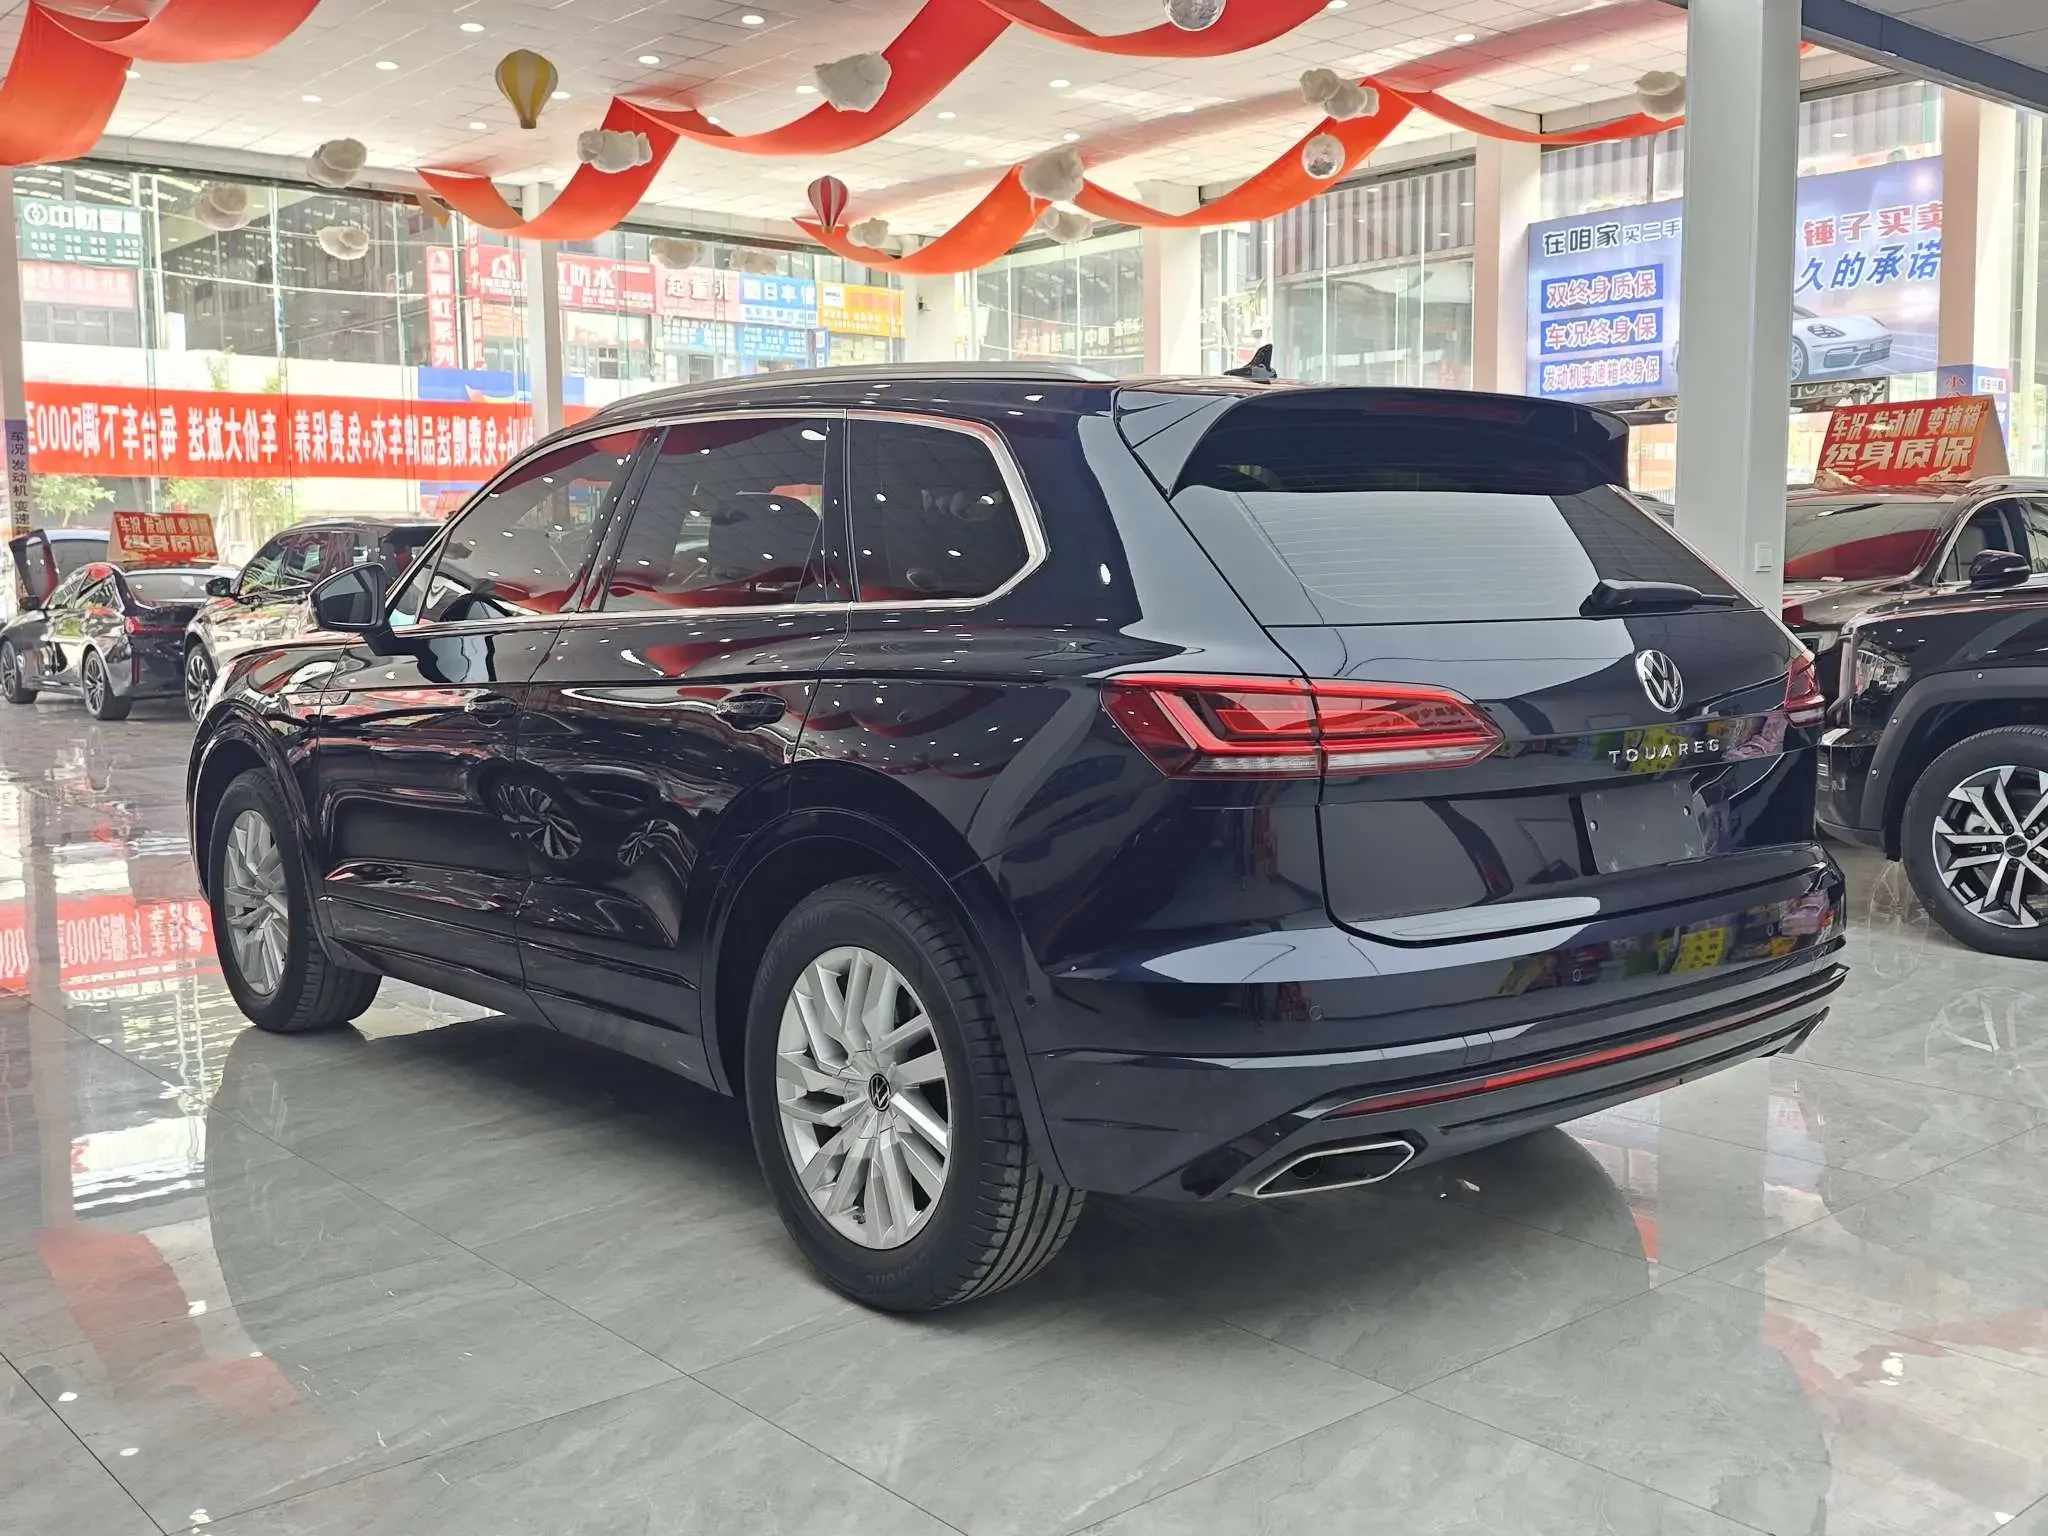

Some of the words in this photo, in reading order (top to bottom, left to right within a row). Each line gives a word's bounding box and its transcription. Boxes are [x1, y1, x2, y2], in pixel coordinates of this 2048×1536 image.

[1802, 201, 1943, 247] 锤子买卖
[1795, 240, 1942, 293] 久的承诺
[1547, 270, 1656, 308] 双终身质保
[1546, 314, 1657, 349] 车况终身保
[1544, 355, 1660, 391] 发动机变速箱终身保
[1831, 412, 1868, 441] 车况
[1925, 403, 1984, 437] 变速箱
[1823, 436, 1975, 472] 终身质保
[1608, 739, 1720, 764] TOUAREG
